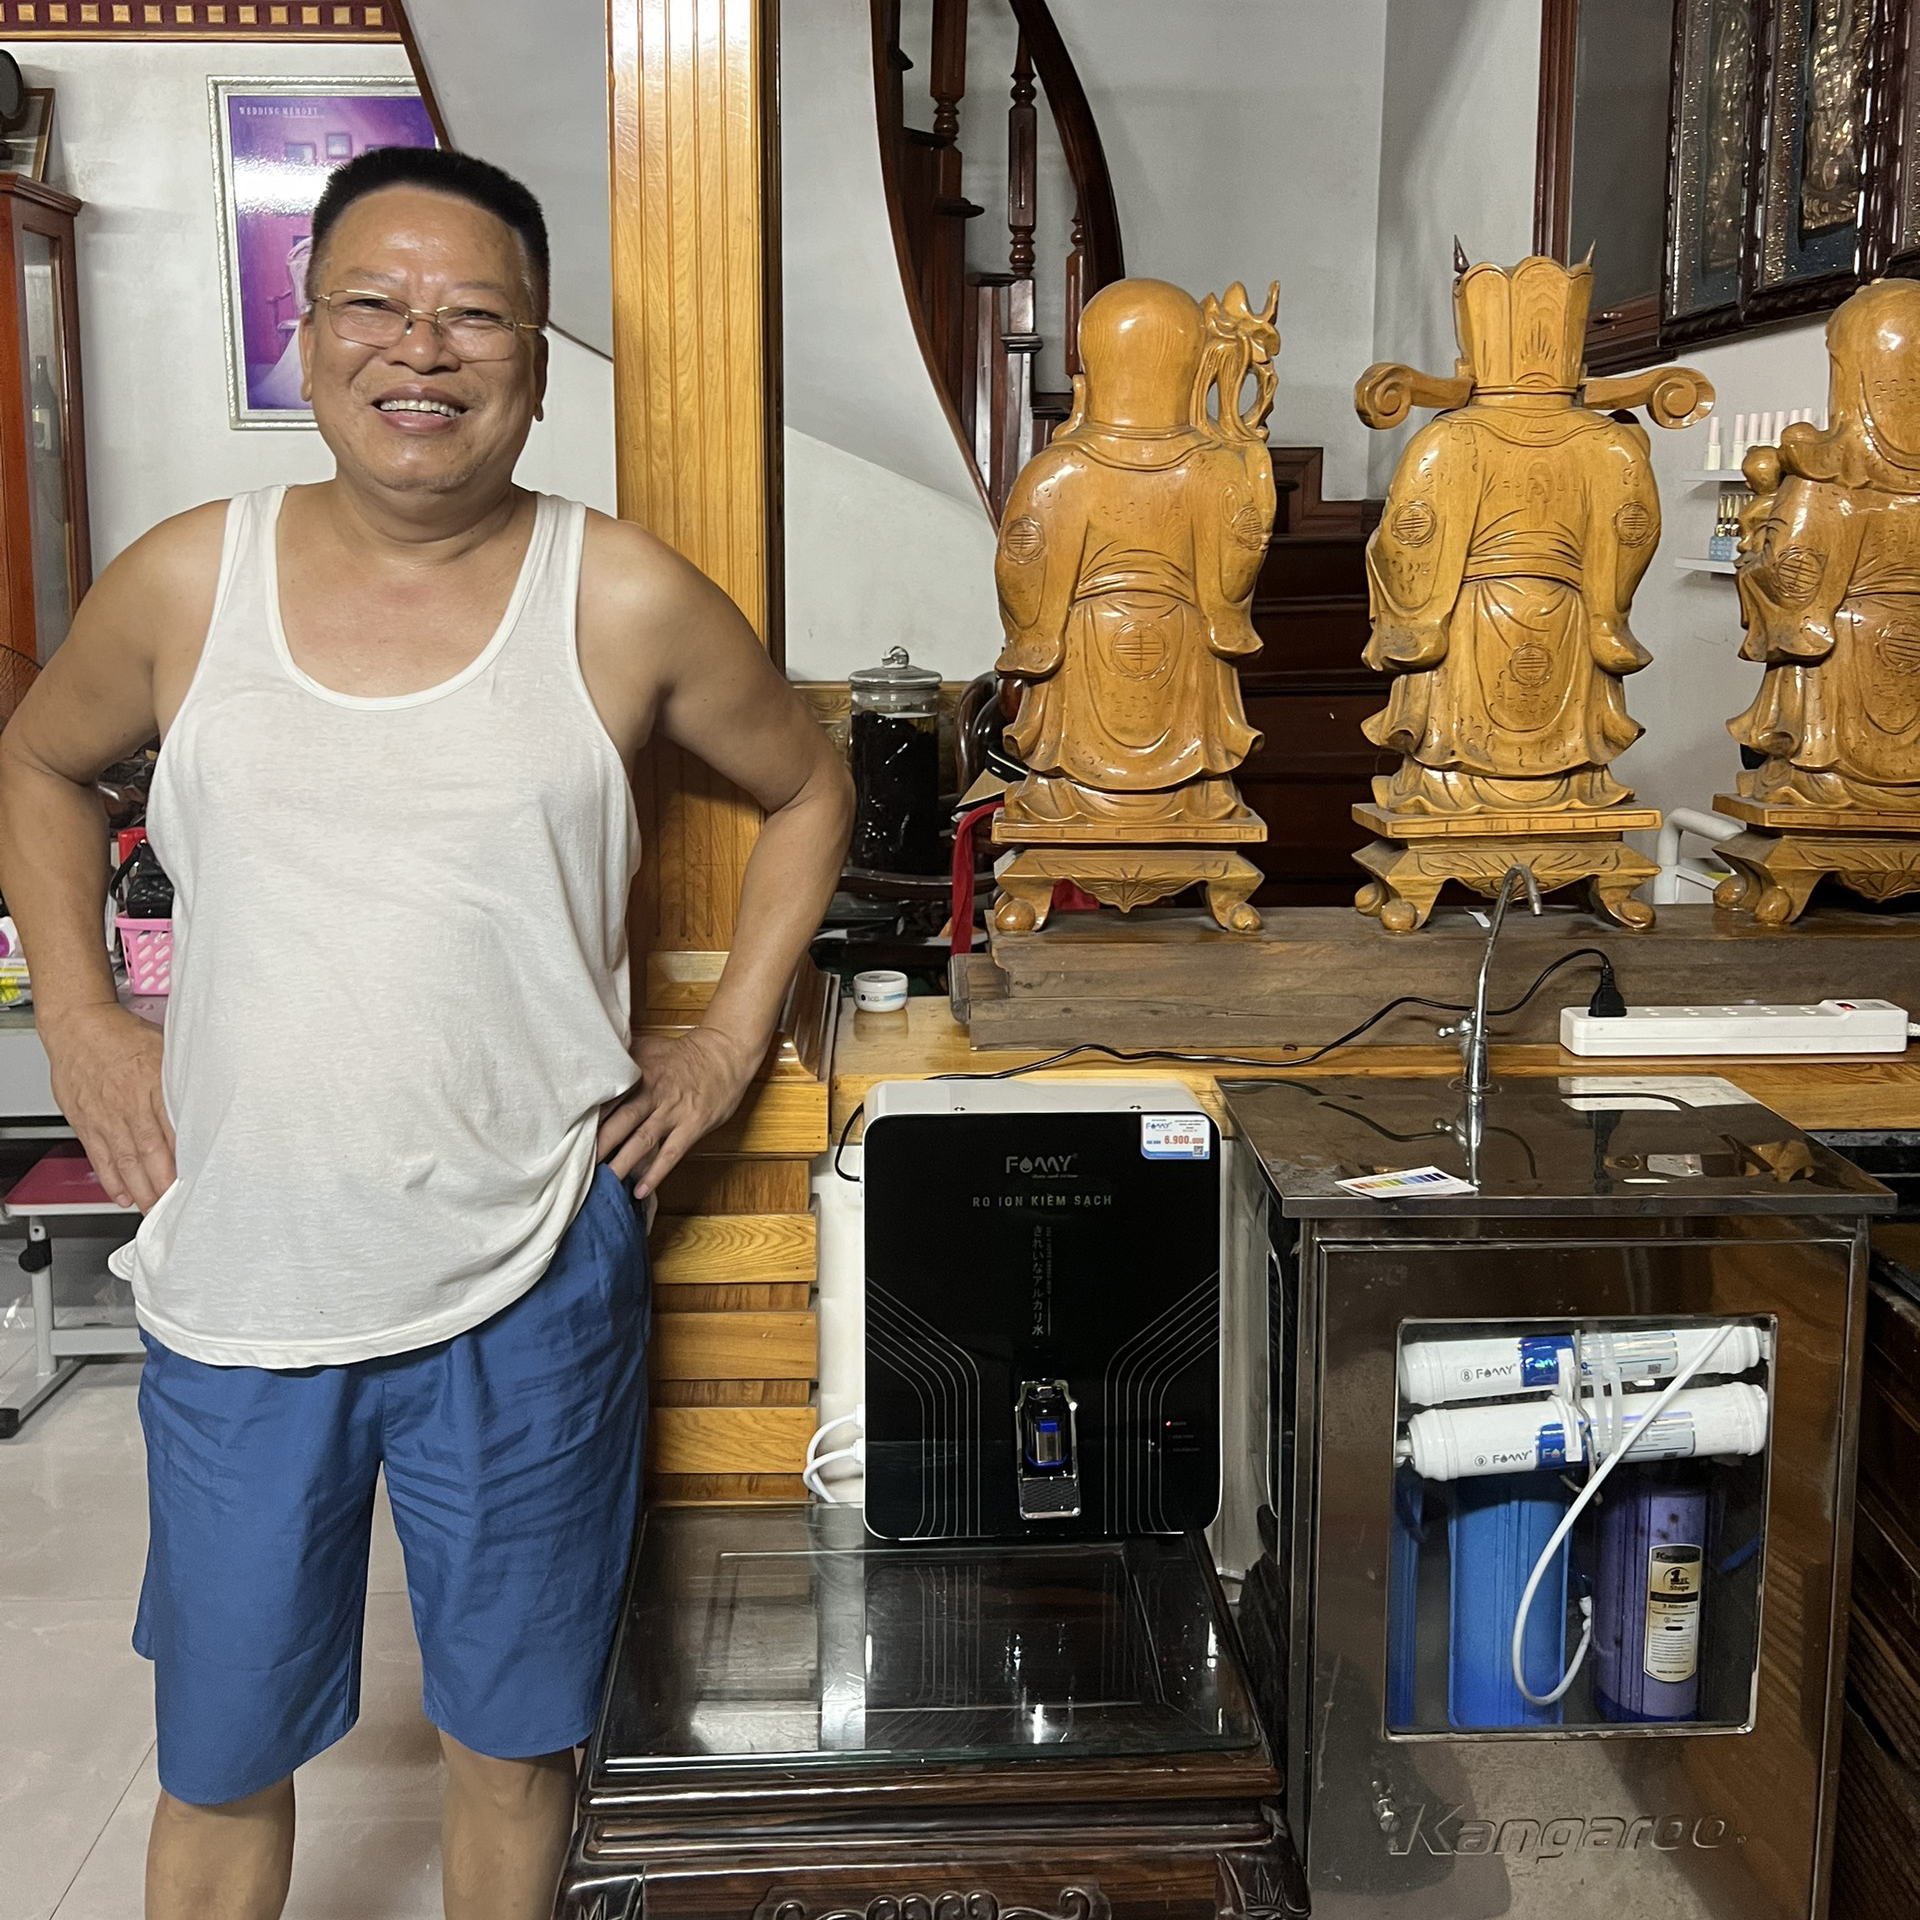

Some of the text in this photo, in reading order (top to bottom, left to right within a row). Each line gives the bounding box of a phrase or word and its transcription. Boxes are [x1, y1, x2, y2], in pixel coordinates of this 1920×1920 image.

[239, 106, 318, 116] WEDDING MEMORY
[972, 1196, 990, 1207] RO
[998, 1196, 1023, 1207] ION
[1074, 1195, 1112, 1207] SẠCH
[1031, 1224, 1044, 1336] きれいなアルカリ水
[1390, 1803, 1725, 1864] Kangaroo
